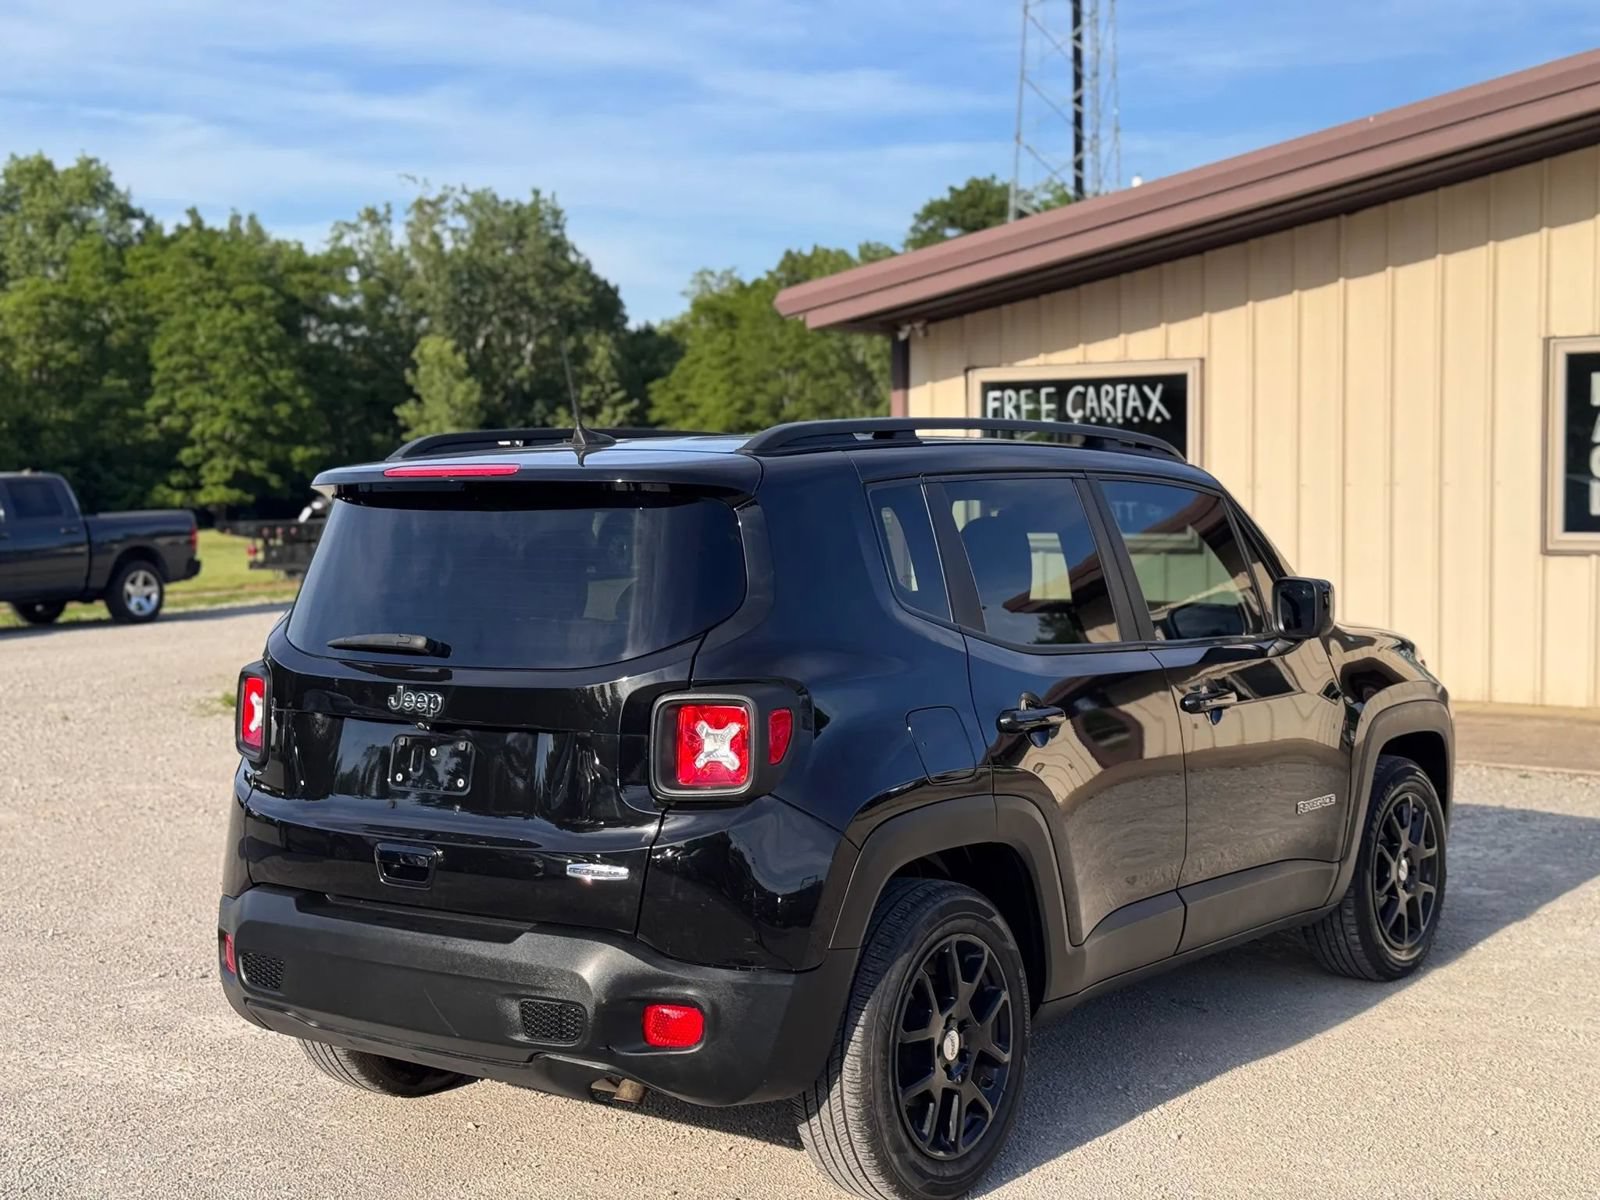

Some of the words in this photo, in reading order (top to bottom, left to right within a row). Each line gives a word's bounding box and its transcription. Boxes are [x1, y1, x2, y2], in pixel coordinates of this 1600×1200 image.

[986, 386, 1057, 422] FREE
[1065, 382, 1172, 423] CARFAX
[387, 685, 443, 717] Jeep
